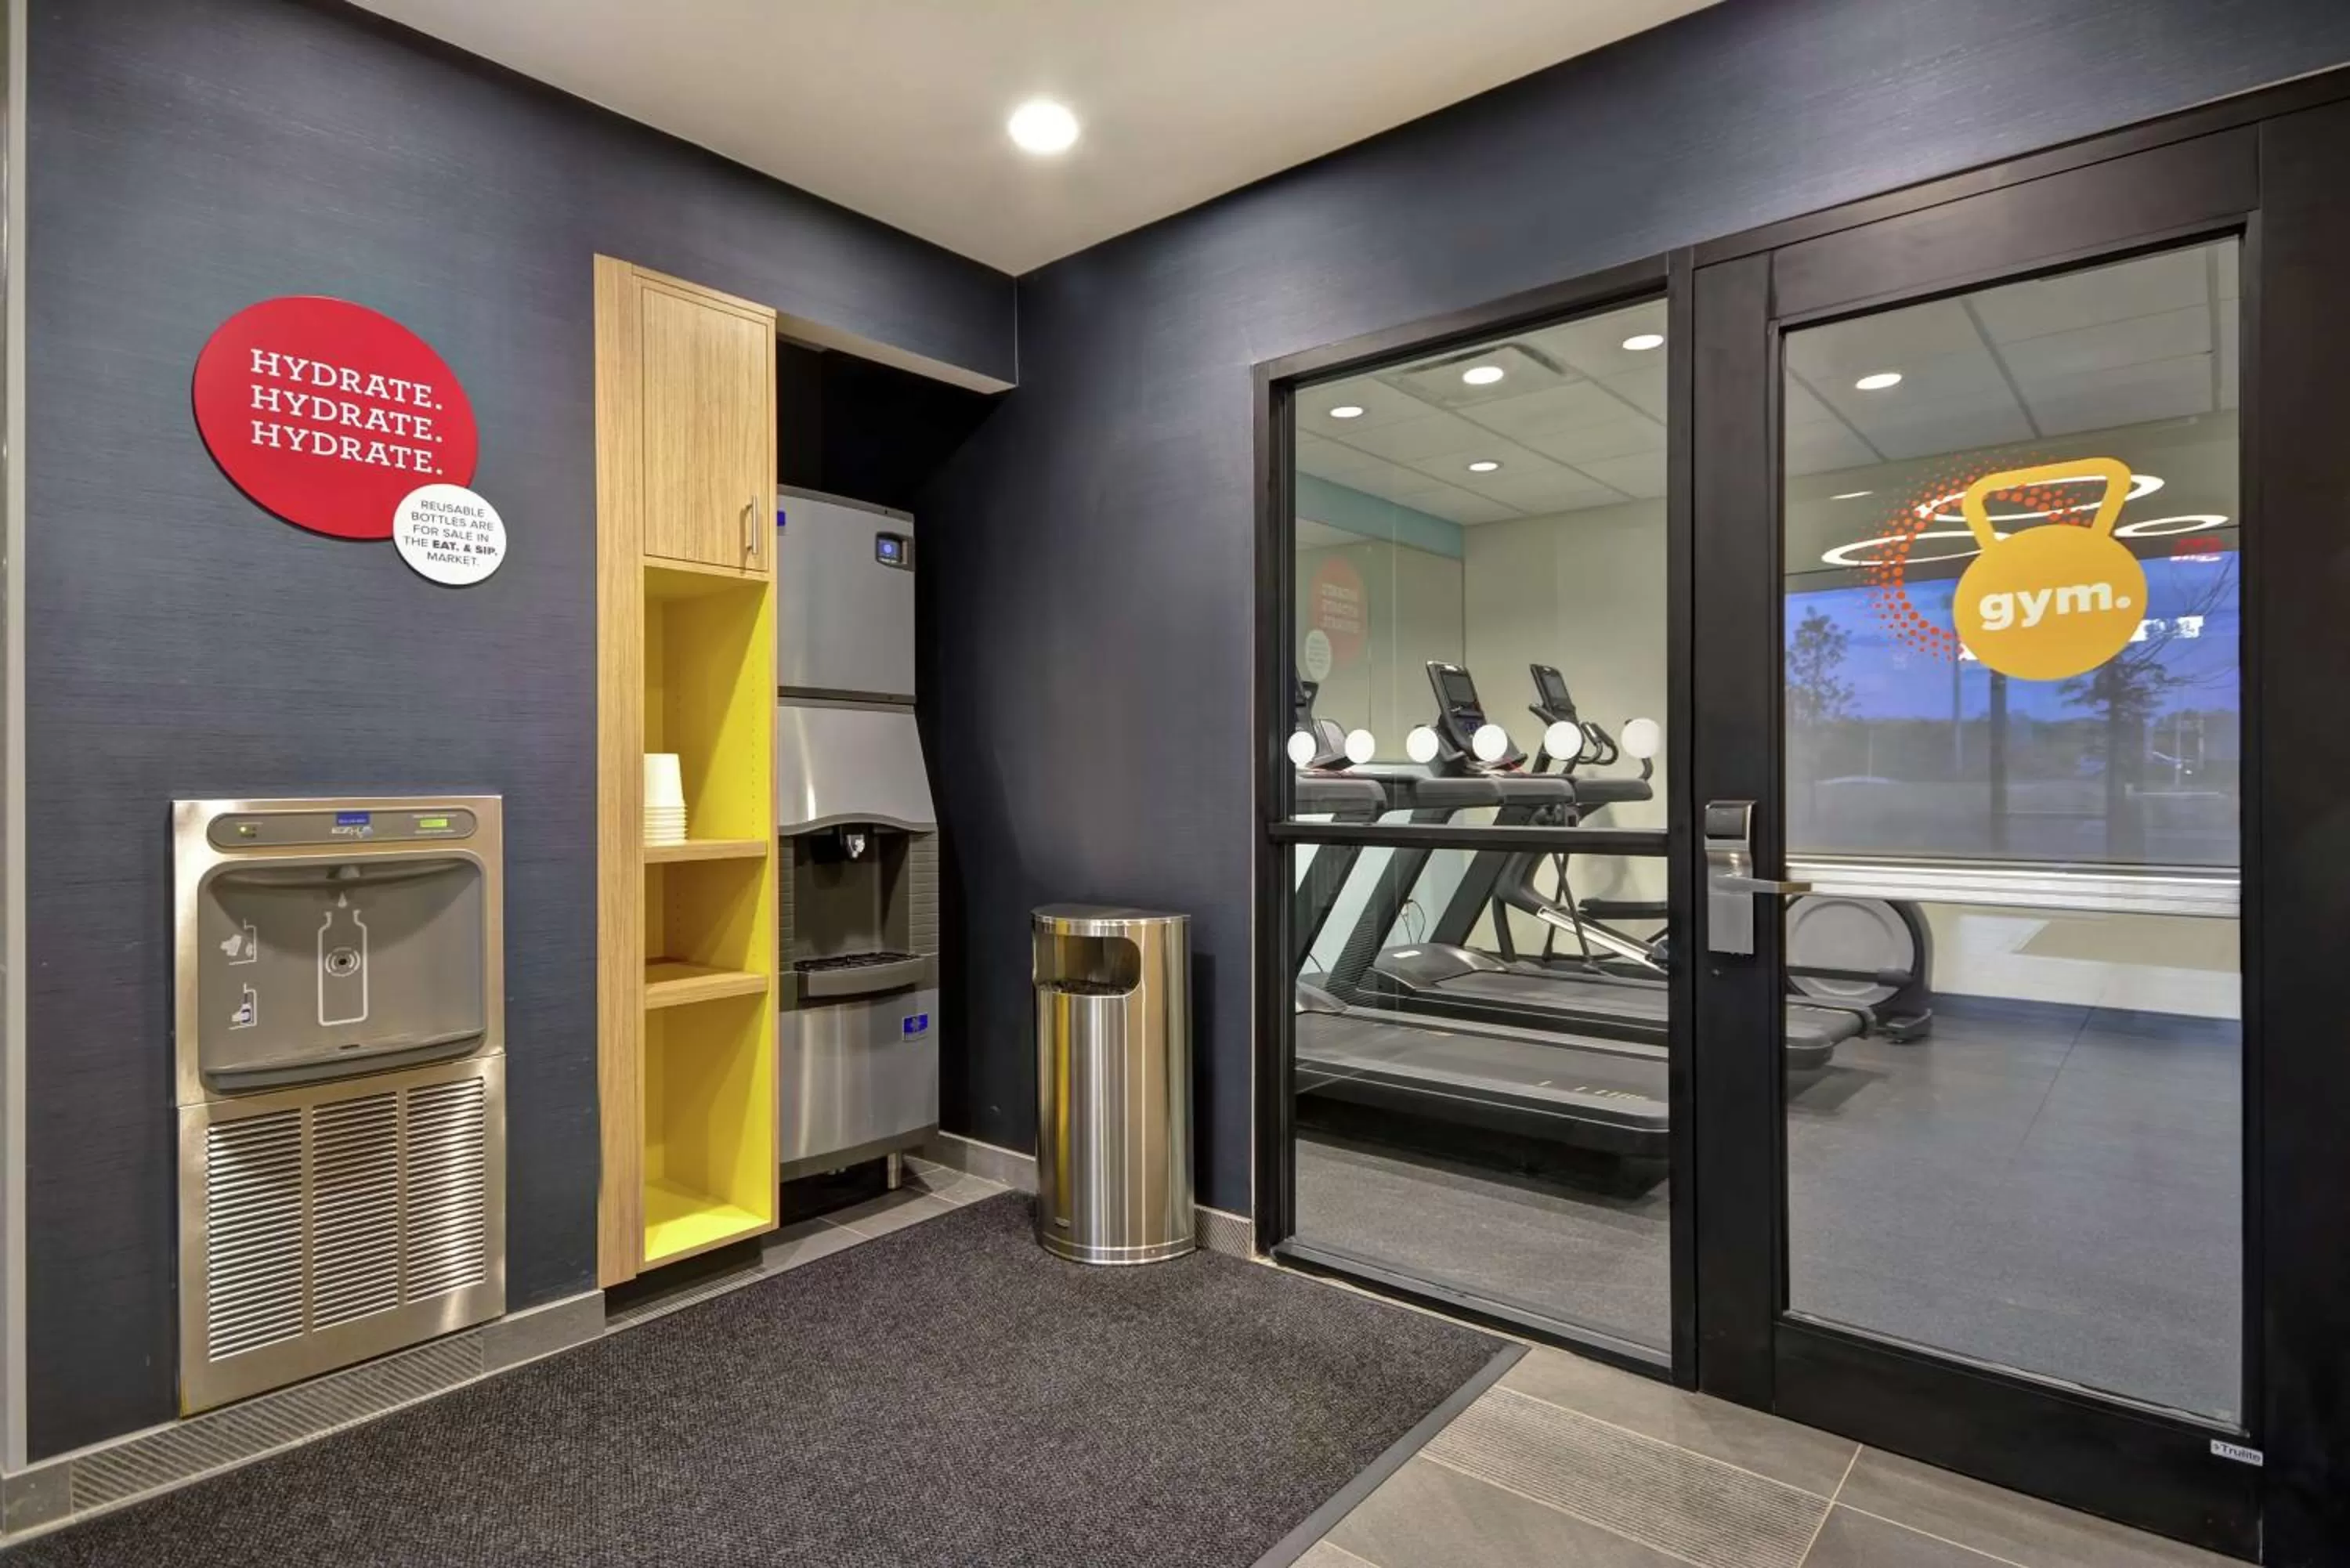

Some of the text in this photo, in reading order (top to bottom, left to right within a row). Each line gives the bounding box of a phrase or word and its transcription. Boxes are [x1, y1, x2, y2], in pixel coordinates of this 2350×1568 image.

[250, 349, 443, 410] HYDRATE.
[250, 385, 443, 443] HYDRATE.
[250, 420, 443, 475] HYDRATE.
[421, 500, 485, 518] REUSABLE
[411, 511, 494, 531] BOTTLES ARE
[413, 524, 489, 542] FOR SALE IN
[403, 536, 497, 556] THE EAT. & SIP.
[427, 551, 479, 566] MARKET.
[1979, 582, 2131, 630] gym.
